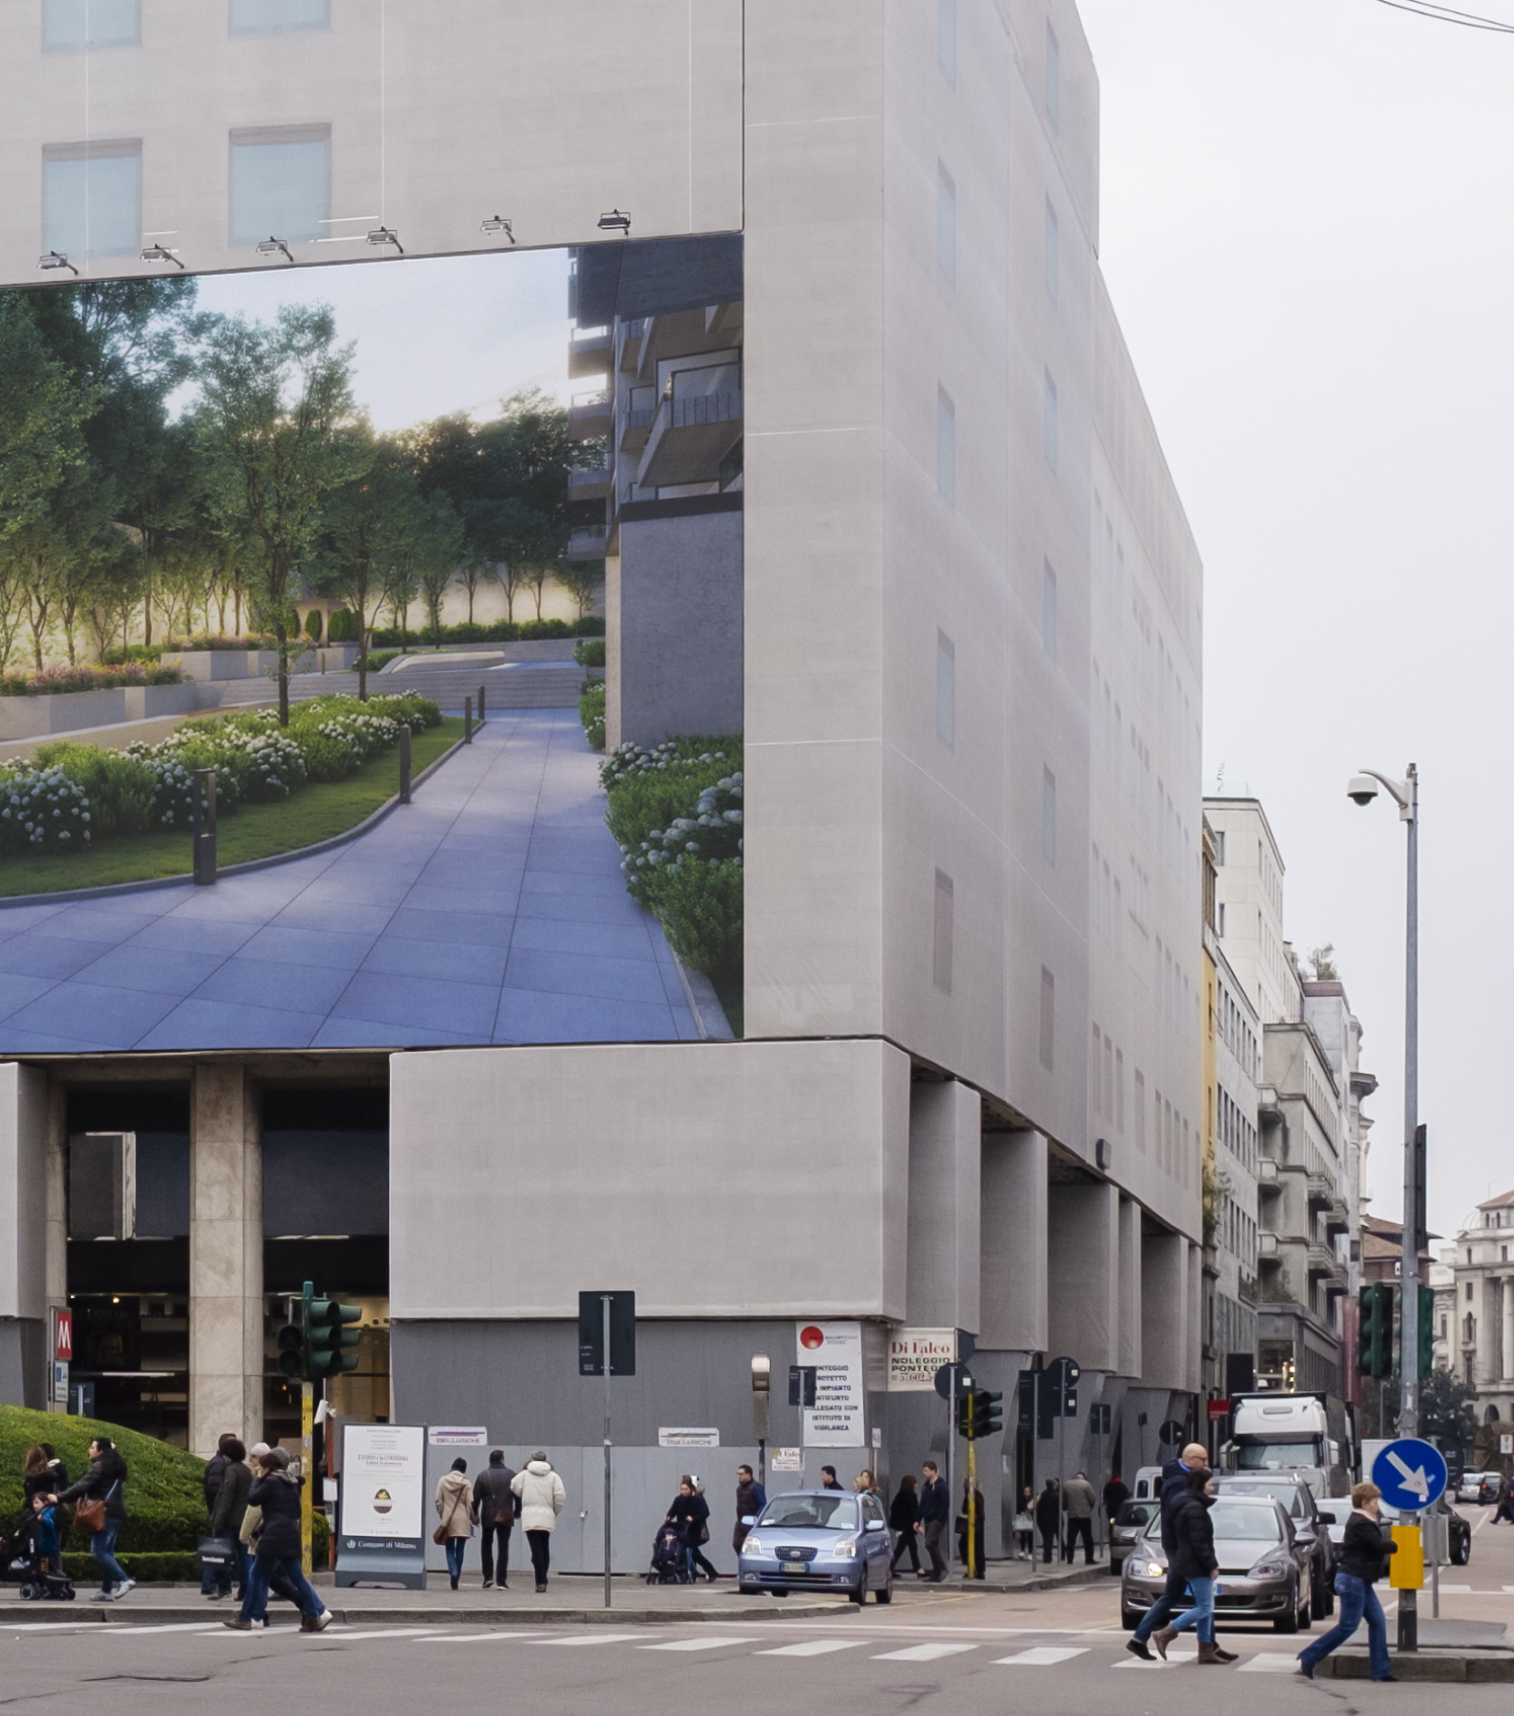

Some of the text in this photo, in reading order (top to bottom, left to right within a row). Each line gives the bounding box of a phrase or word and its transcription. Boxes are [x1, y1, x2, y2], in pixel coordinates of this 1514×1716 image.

[57, 1320, 72, 1351] M
[891, 1341, 950, 1355] Di Falco
